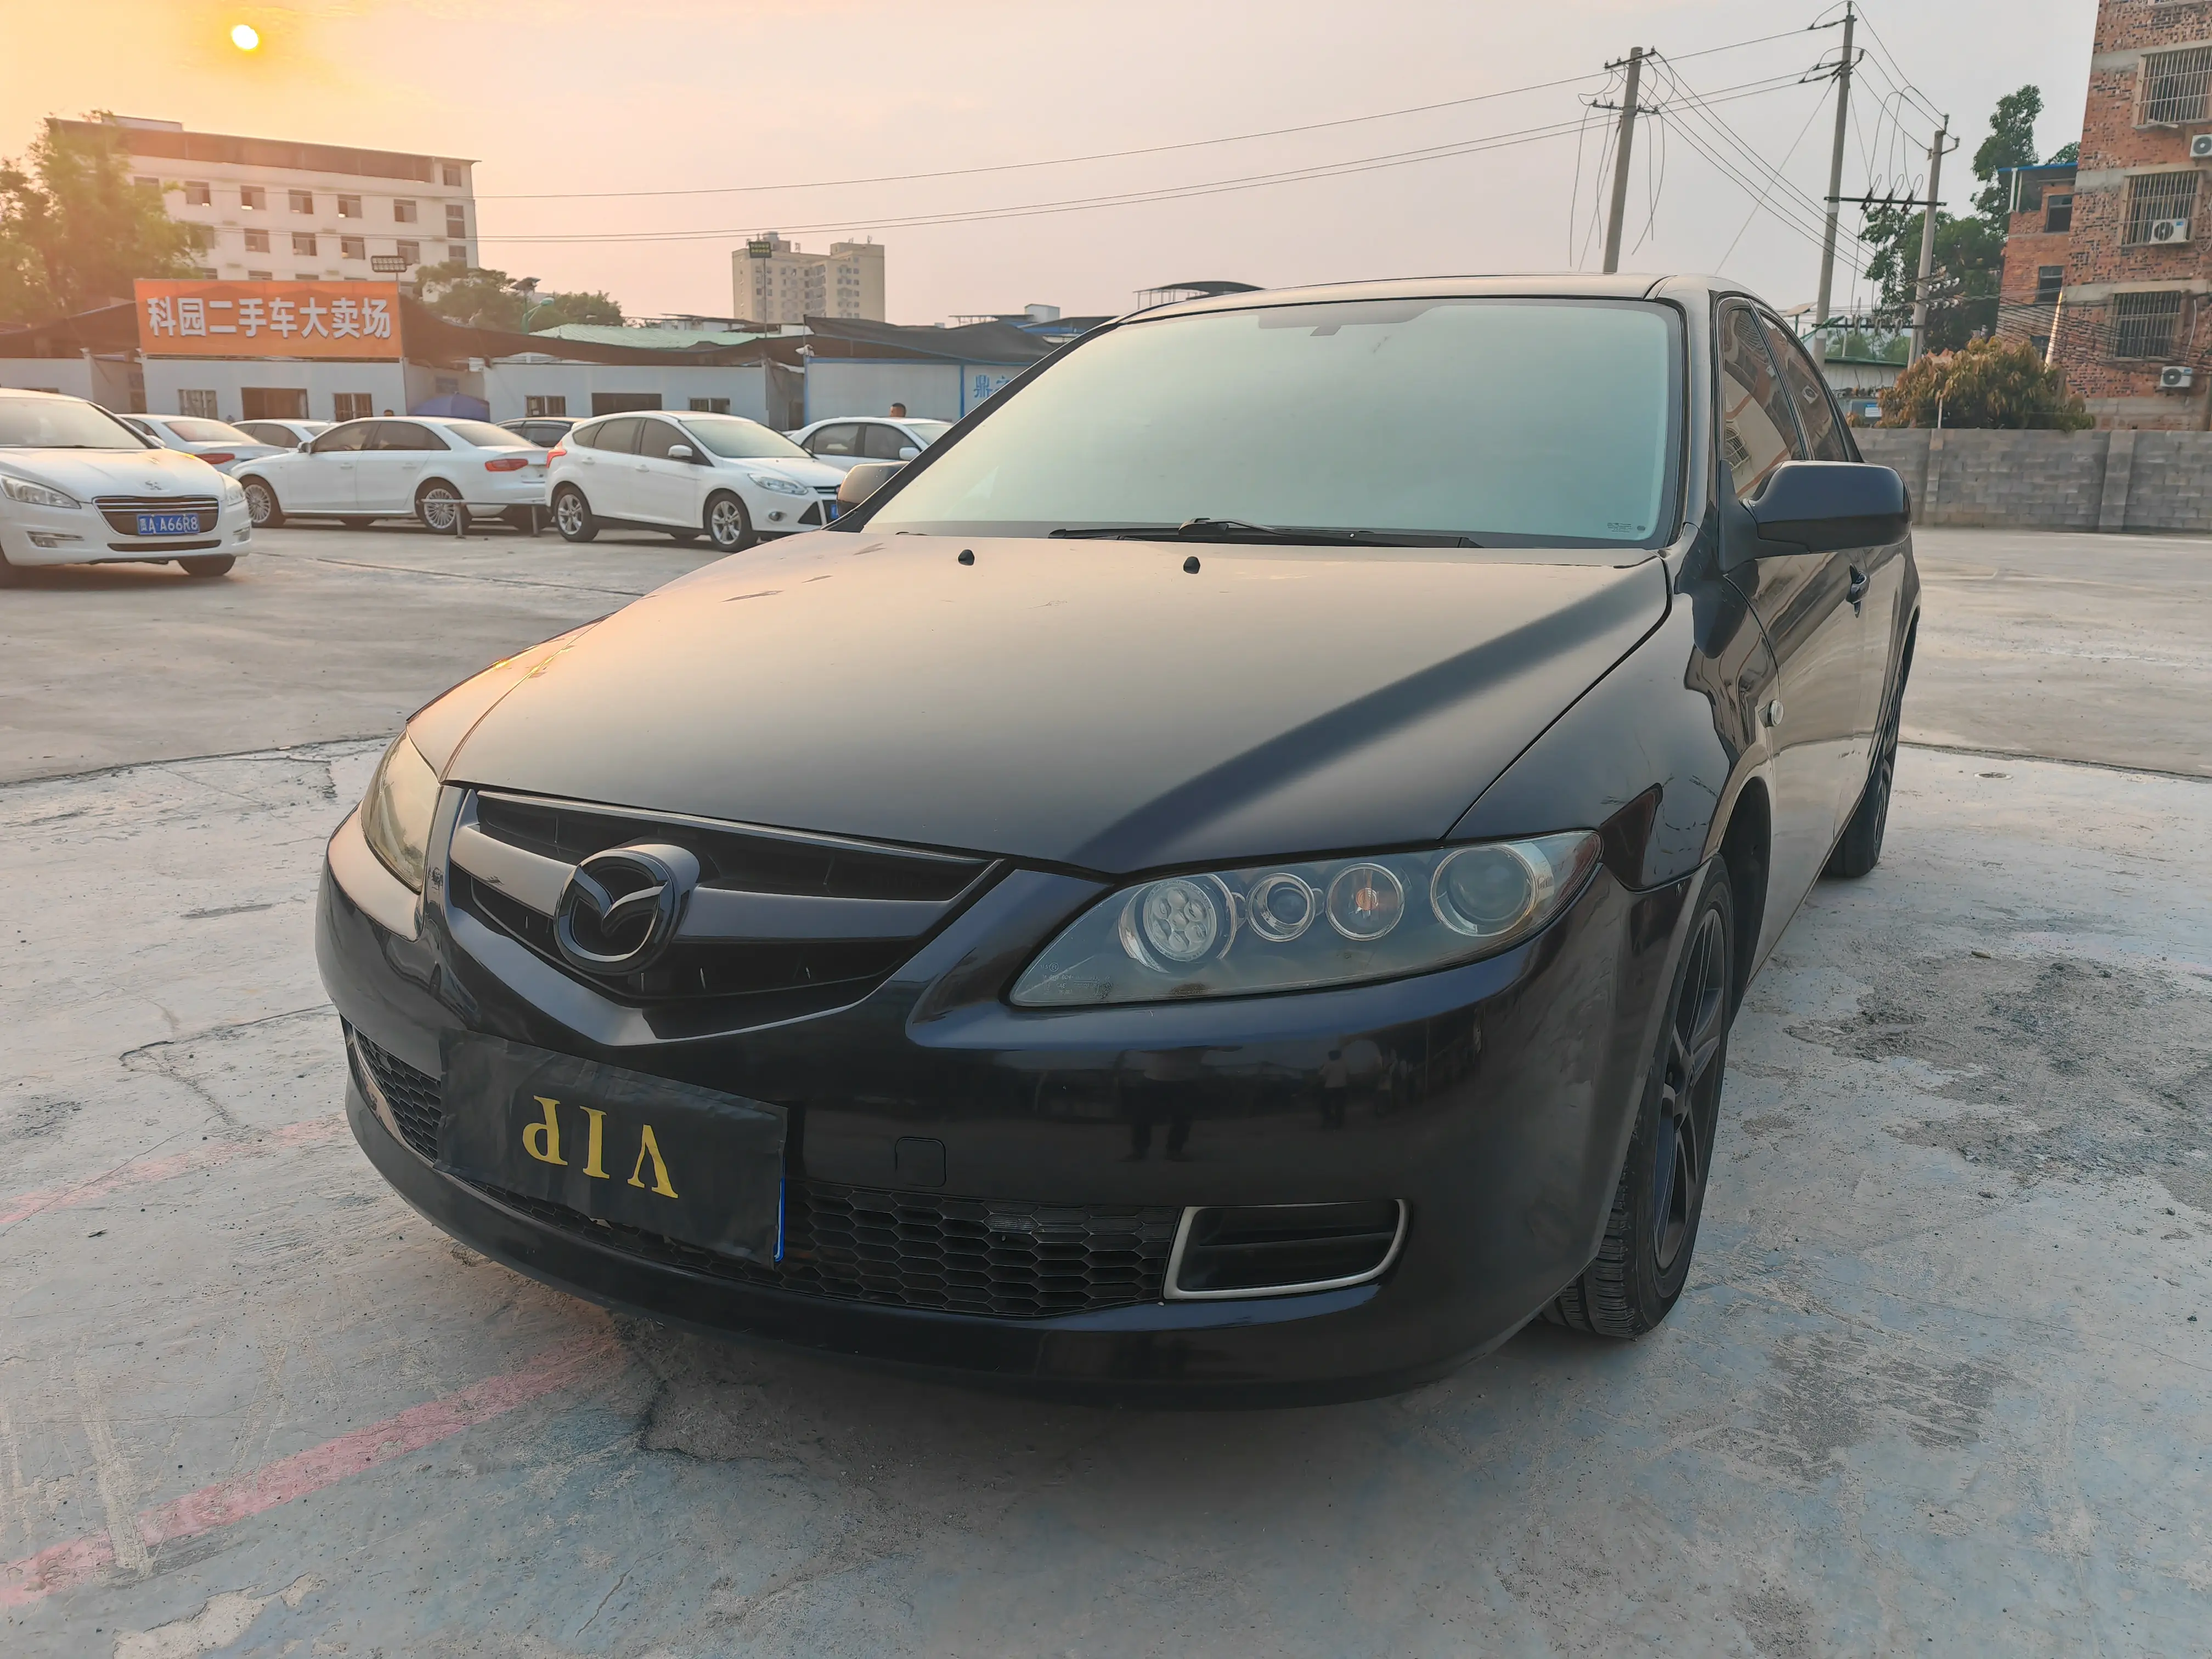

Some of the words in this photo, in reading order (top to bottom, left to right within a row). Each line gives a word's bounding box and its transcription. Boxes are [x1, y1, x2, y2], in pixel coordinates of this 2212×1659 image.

[147, 296, 391, 339] 科园二手车大卖场
[973, 374, 1011, 398] 鼎
[522, 1095, 679, 1199] VIP
